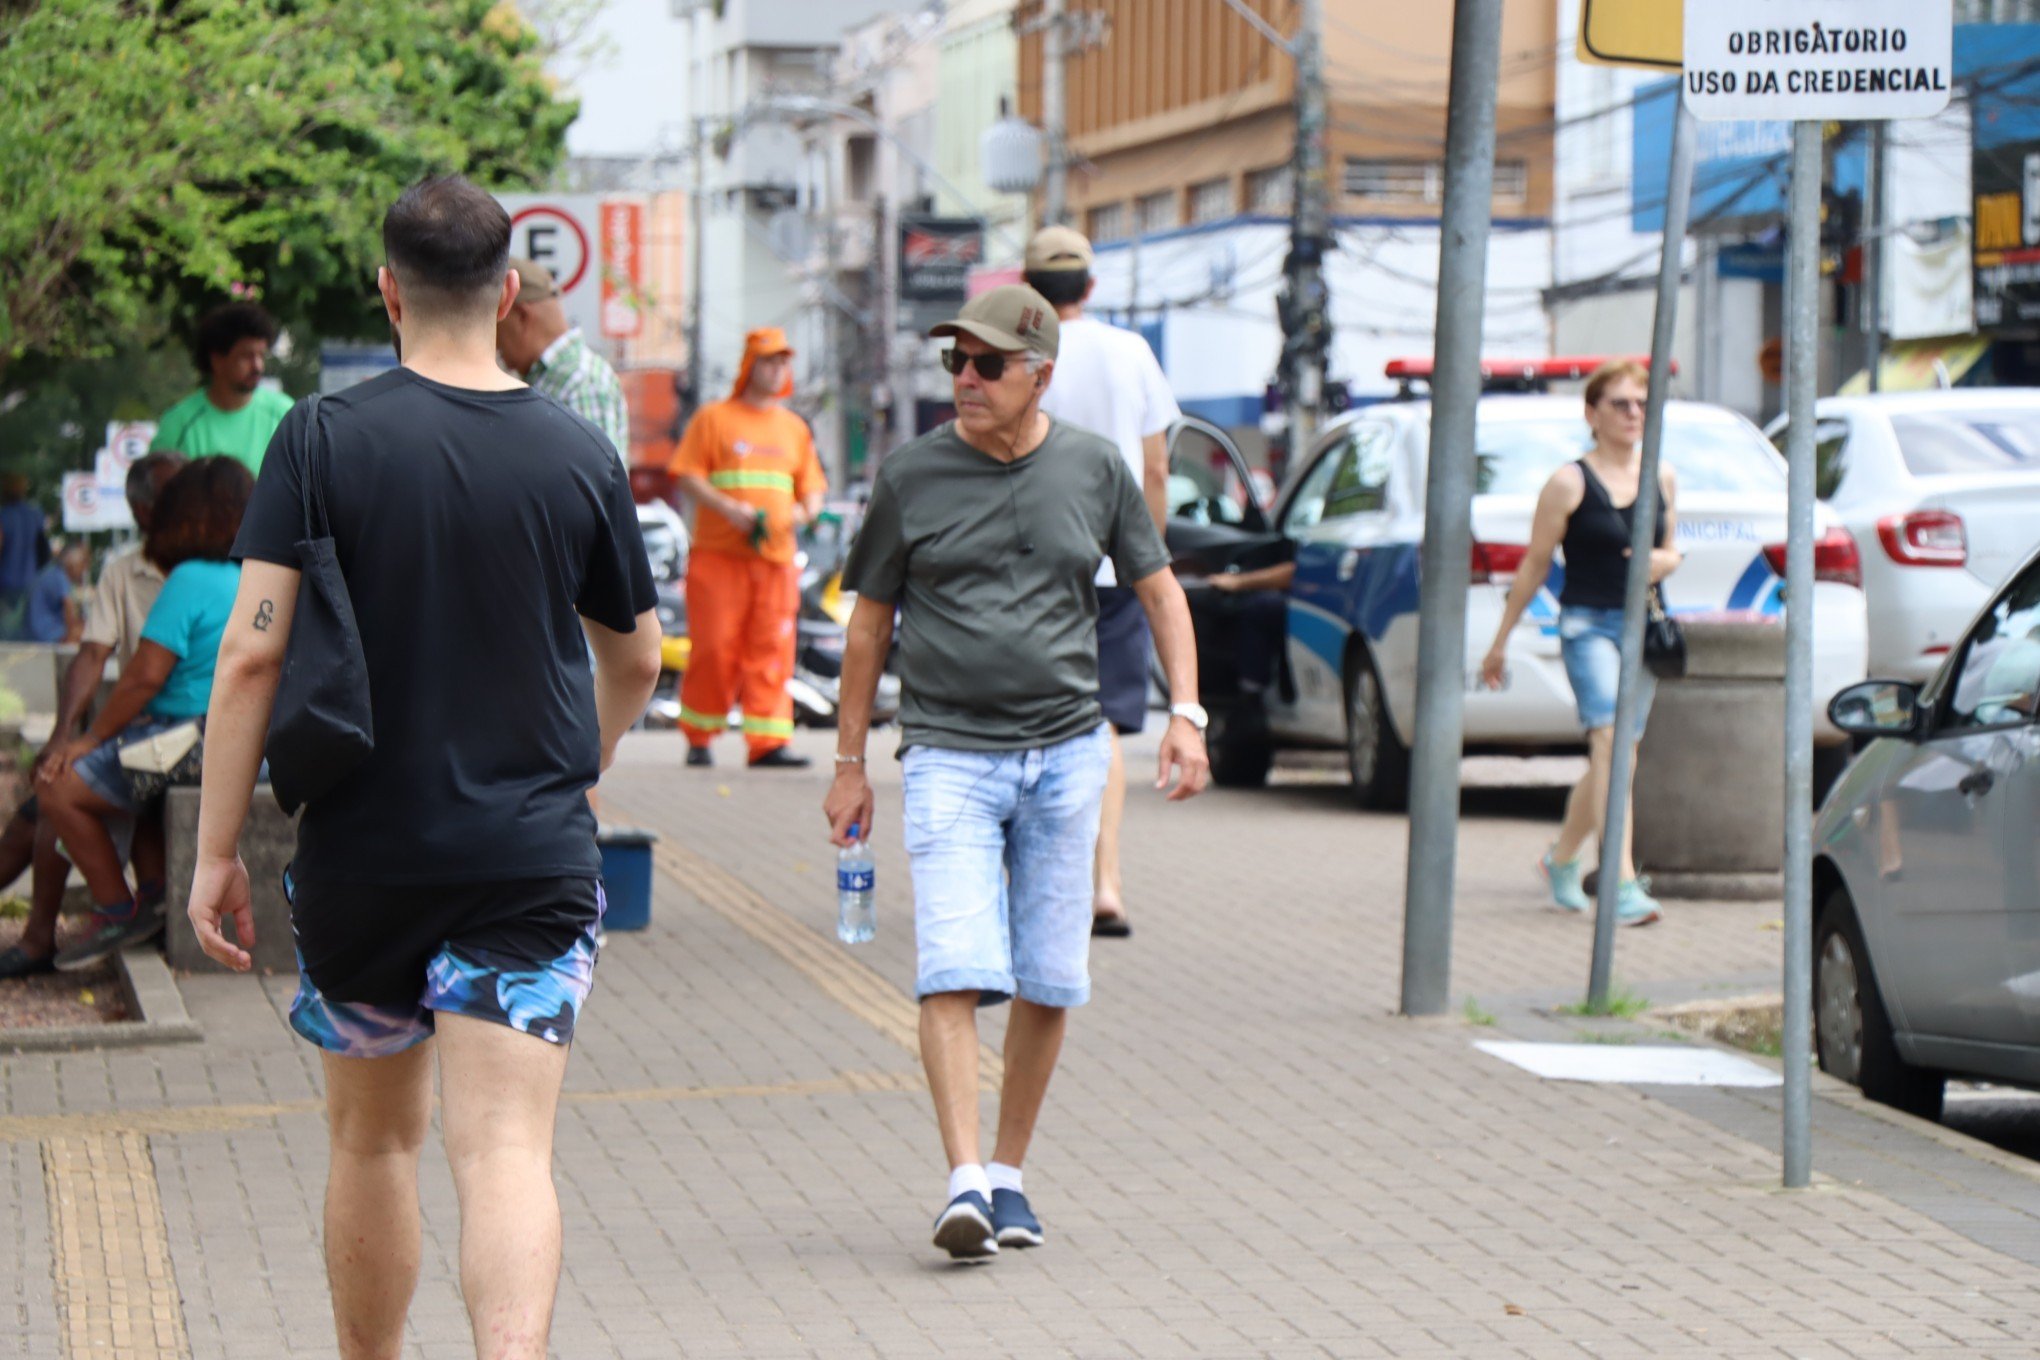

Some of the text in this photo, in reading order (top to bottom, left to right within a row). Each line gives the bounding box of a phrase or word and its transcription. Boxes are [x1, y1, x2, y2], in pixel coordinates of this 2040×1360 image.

[1689, 67, 1947, 95] USO DA CREDENCIAL
[1677, 519, 1760, 542] NICIPAL
